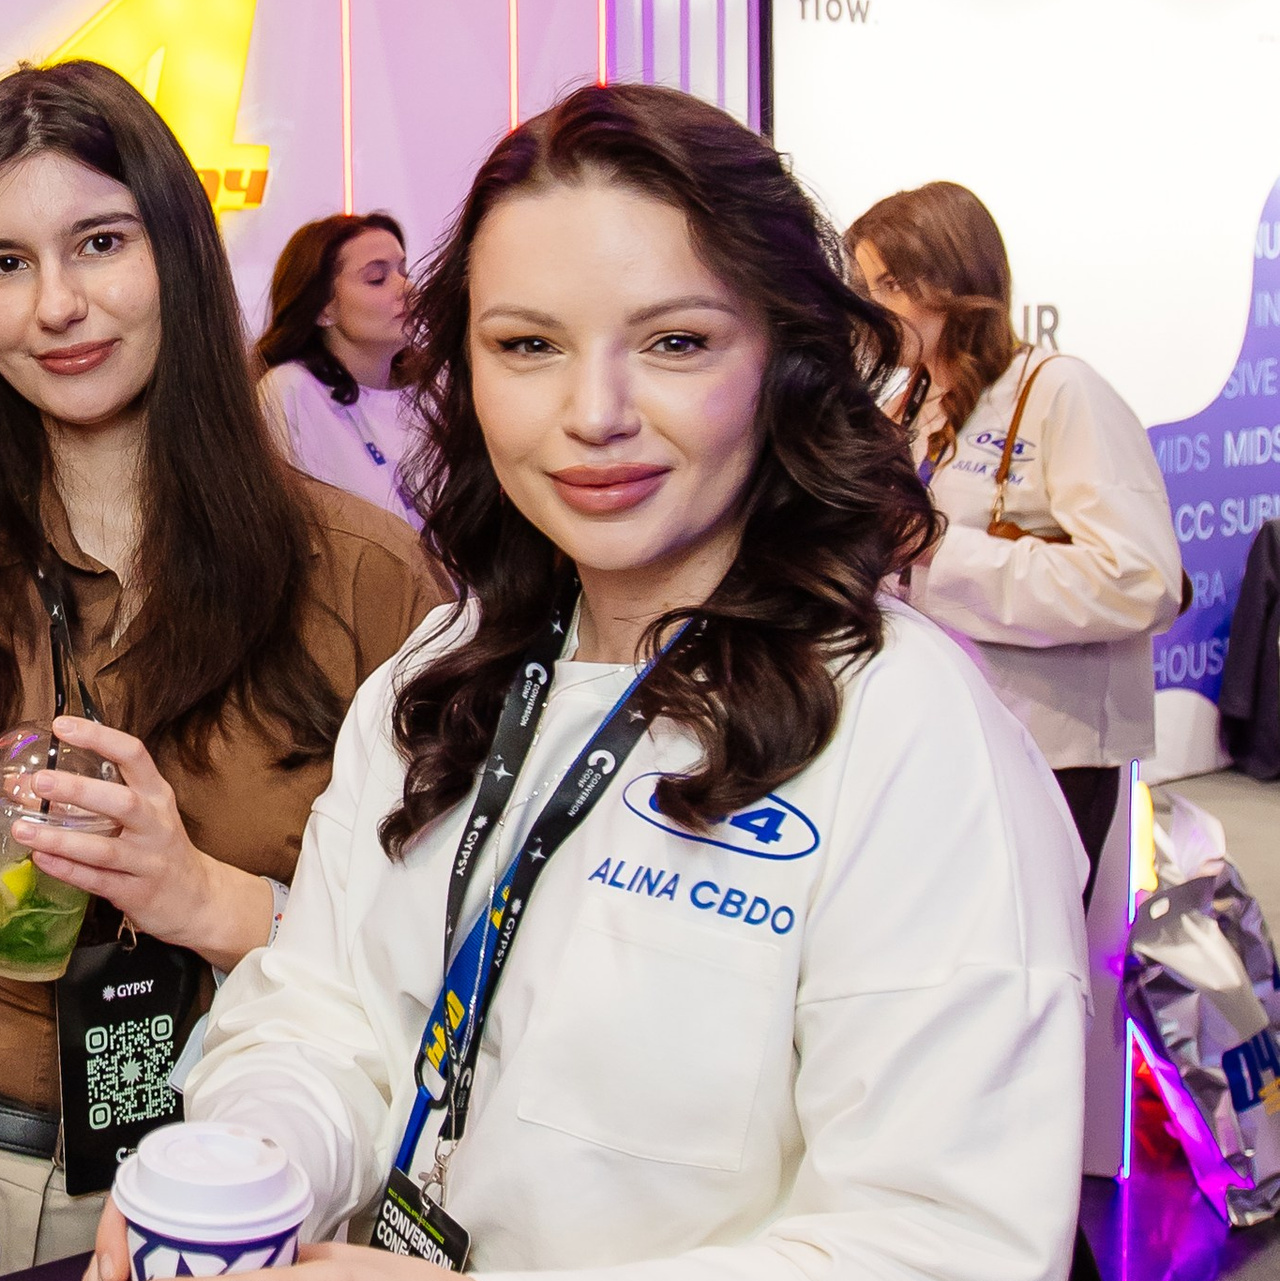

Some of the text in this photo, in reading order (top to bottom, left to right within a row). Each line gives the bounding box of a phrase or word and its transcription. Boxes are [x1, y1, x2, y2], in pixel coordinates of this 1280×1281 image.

[520, 683, 541, 728] CONVERSION
[522, 679, 533, 700] CONF
[566, 772, 603, 818] CONVERSION
[577, 768, 594, 789] CONF
[455, 830, 480, 877] GYPSY
[587, 856, 796, 936] ALINA CBDO
[494, 917, 516, 969] GYPSY
[116, 979, 155, 998] GYPSY
[382, 1199, 454, 1270] CONVERSION
